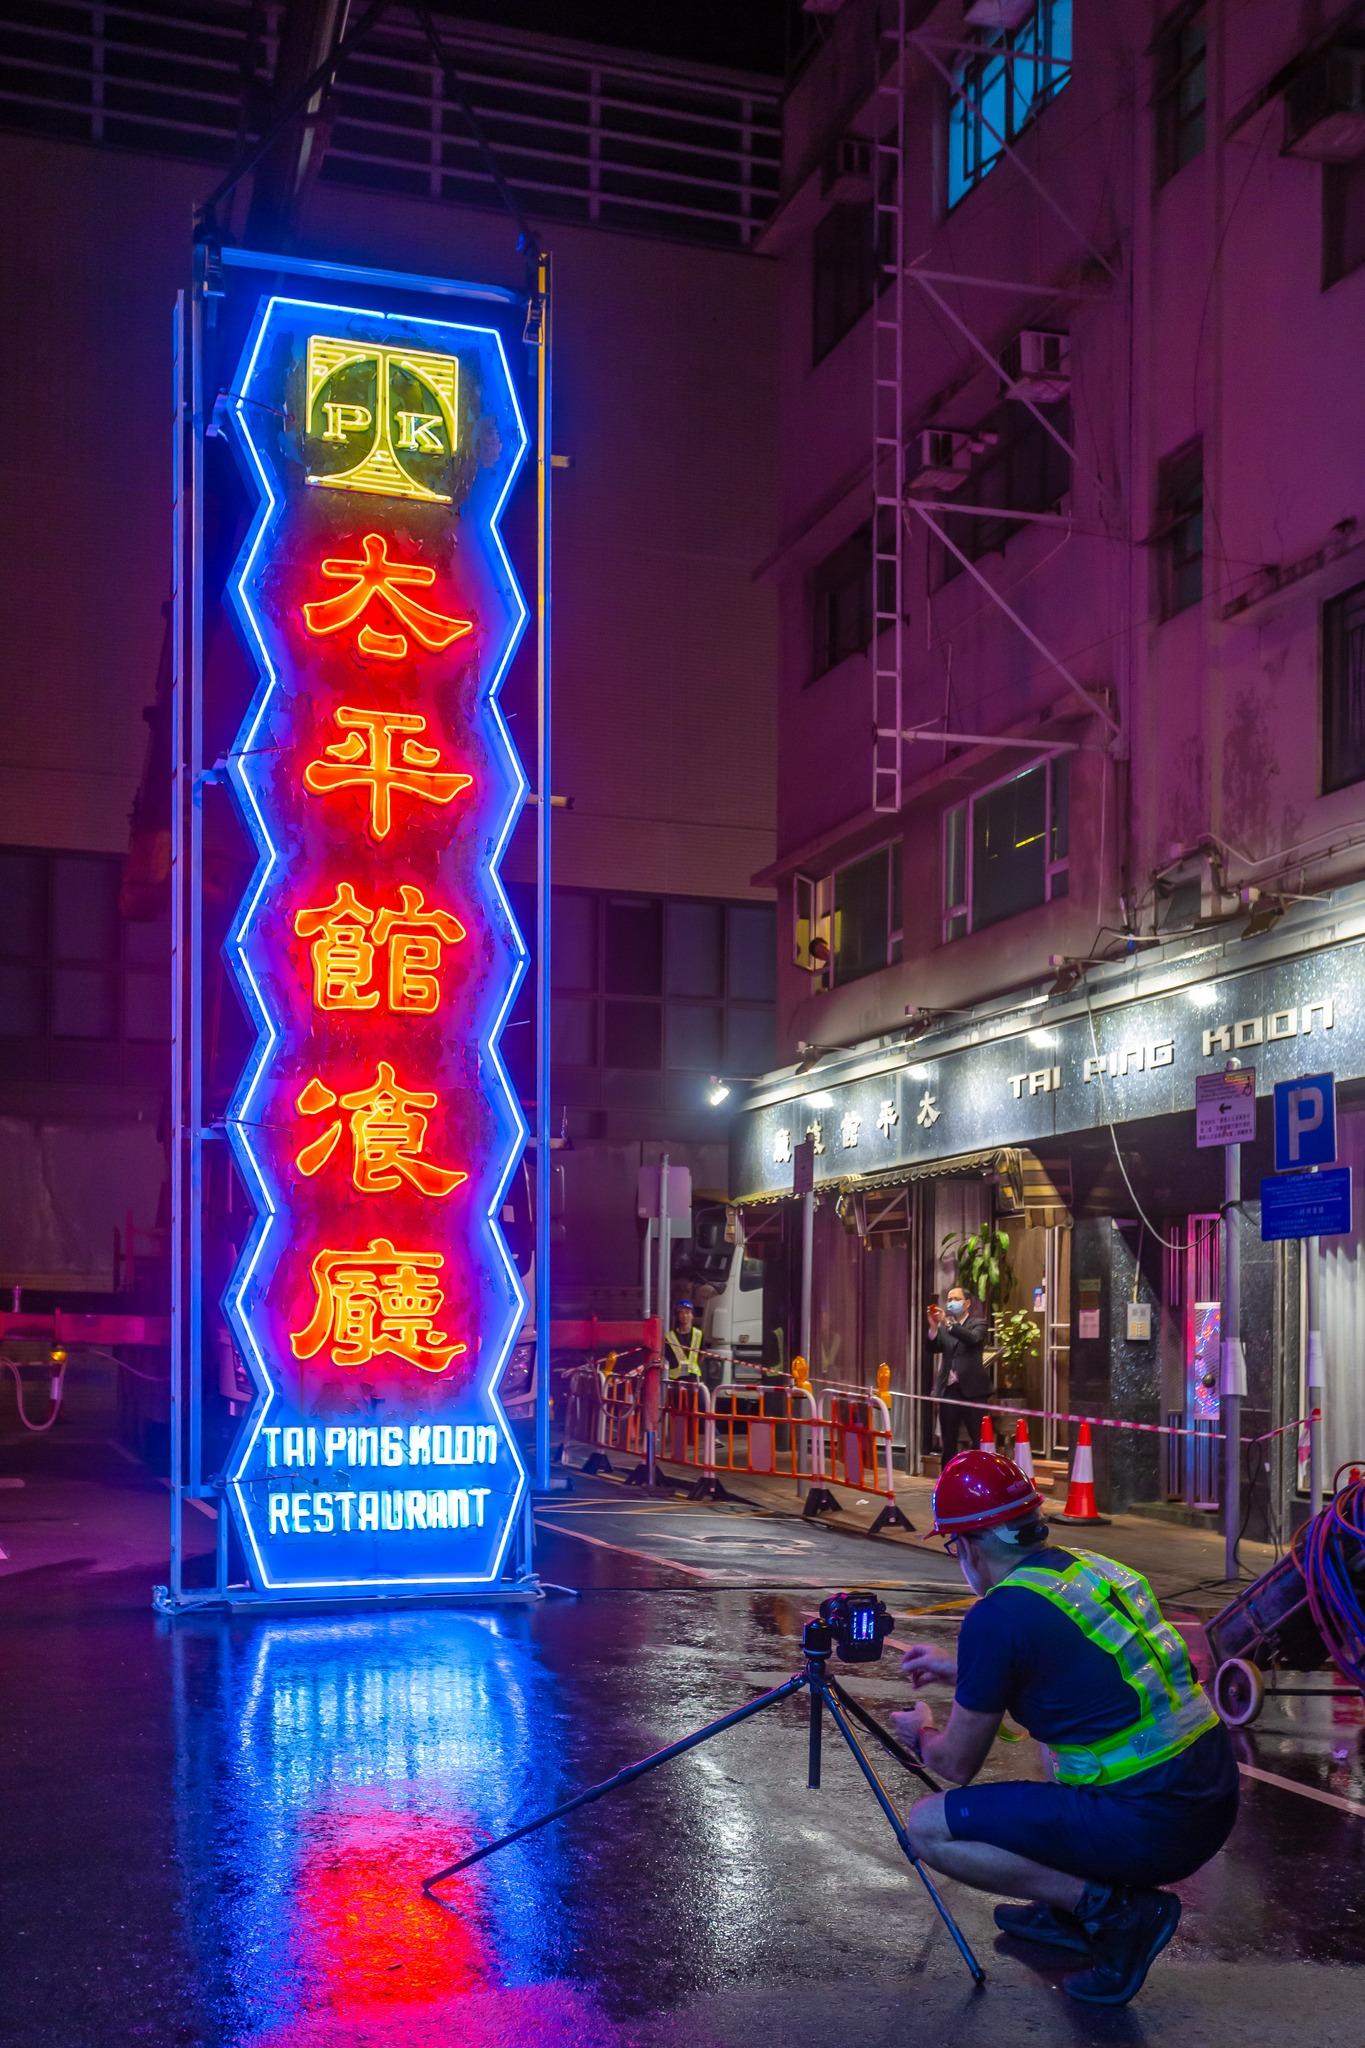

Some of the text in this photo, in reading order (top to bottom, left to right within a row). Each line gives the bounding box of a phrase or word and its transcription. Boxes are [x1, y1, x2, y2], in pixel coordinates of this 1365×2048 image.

[1007, 1000, 1334, 1099] TAI PING KOON
[1288, 1086, 1324, 1162] P
[262, 1424, 498, 1468] TAI PING KOON
[268, 1487, 491, 1535] RESTAURANT
